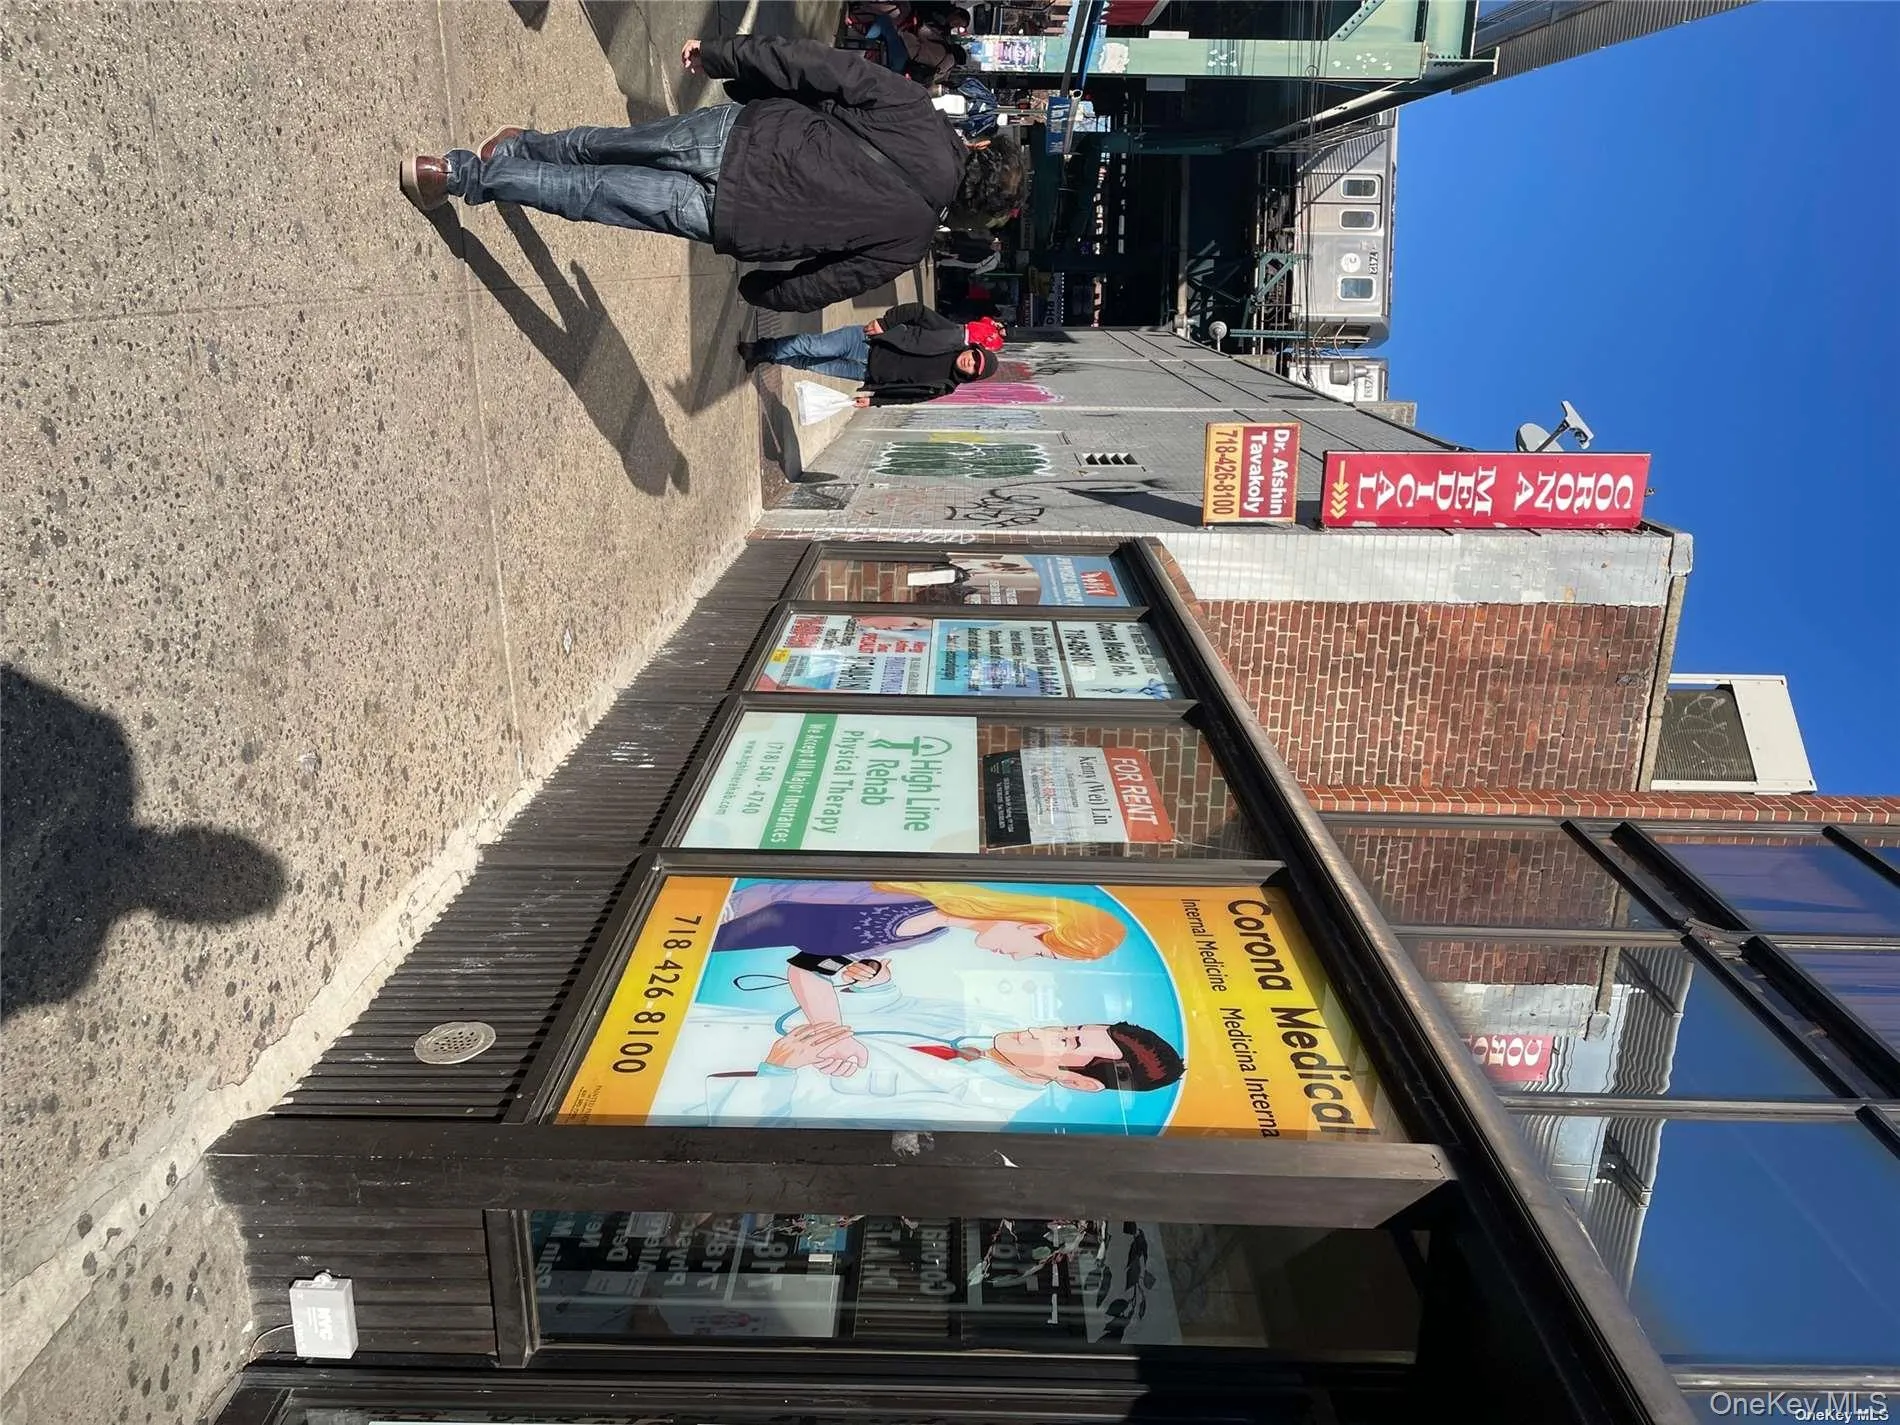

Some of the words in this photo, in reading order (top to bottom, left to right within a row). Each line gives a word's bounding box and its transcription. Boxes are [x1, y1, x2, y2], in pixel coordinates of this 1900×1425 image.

[1271, 428, 1290, 454] Dr.
[1211, 430, 1239, 515] 718-426-8100
[1242, 431, 1267, 513] Tavakoly
[1269, 457, 1289, 515] Afshin
[1356, 466, 1497, 516] MEDICAL
[1514, 471, 1634, 514] CORONA
[1095, 622, 1121, 642] Corona
[1103, 641, 1131, 665] Medical
[797, 733, 823, 758] Accept
[807, 723, 828, 735] We
[760, 742, 785, 763] (718)
[794, 758, 816, 770] All
[832, 730, 864, 776] Physical
[1077, 756, 1098, 780] Kenny
[1110, 757, 1146, 782] FOR
[715, 740, 758, 815] www.highlinerehab.com
[754, 765, 777, 782] 540
[782, 770, 812, 794] Major
[860, 759, 900, 806] Rehab
[901, 759, 943, 793] High
[740, 790, 766, 814] 4740
[811, 779, 858, 834] Therapy
[1080, 781, 1107, 806] (Wei)
[1119, 784, 1159, 826] RENT
[770, 795, 806, 843] Insurances
[903, 797, 941, 832] Line
[1092, 807, 1114, 825] Lin
[1180, 898, 1214, 937] Internal
[1195, 940, 1229, 992] Medicine
[1227, 900, 1295, 991] Corona
[1270, 1007, 1381, 1136] Medical
[1219, 1007, 1257, 1073] Medicina
[1243, 1077, 1281, 1138] Interna
